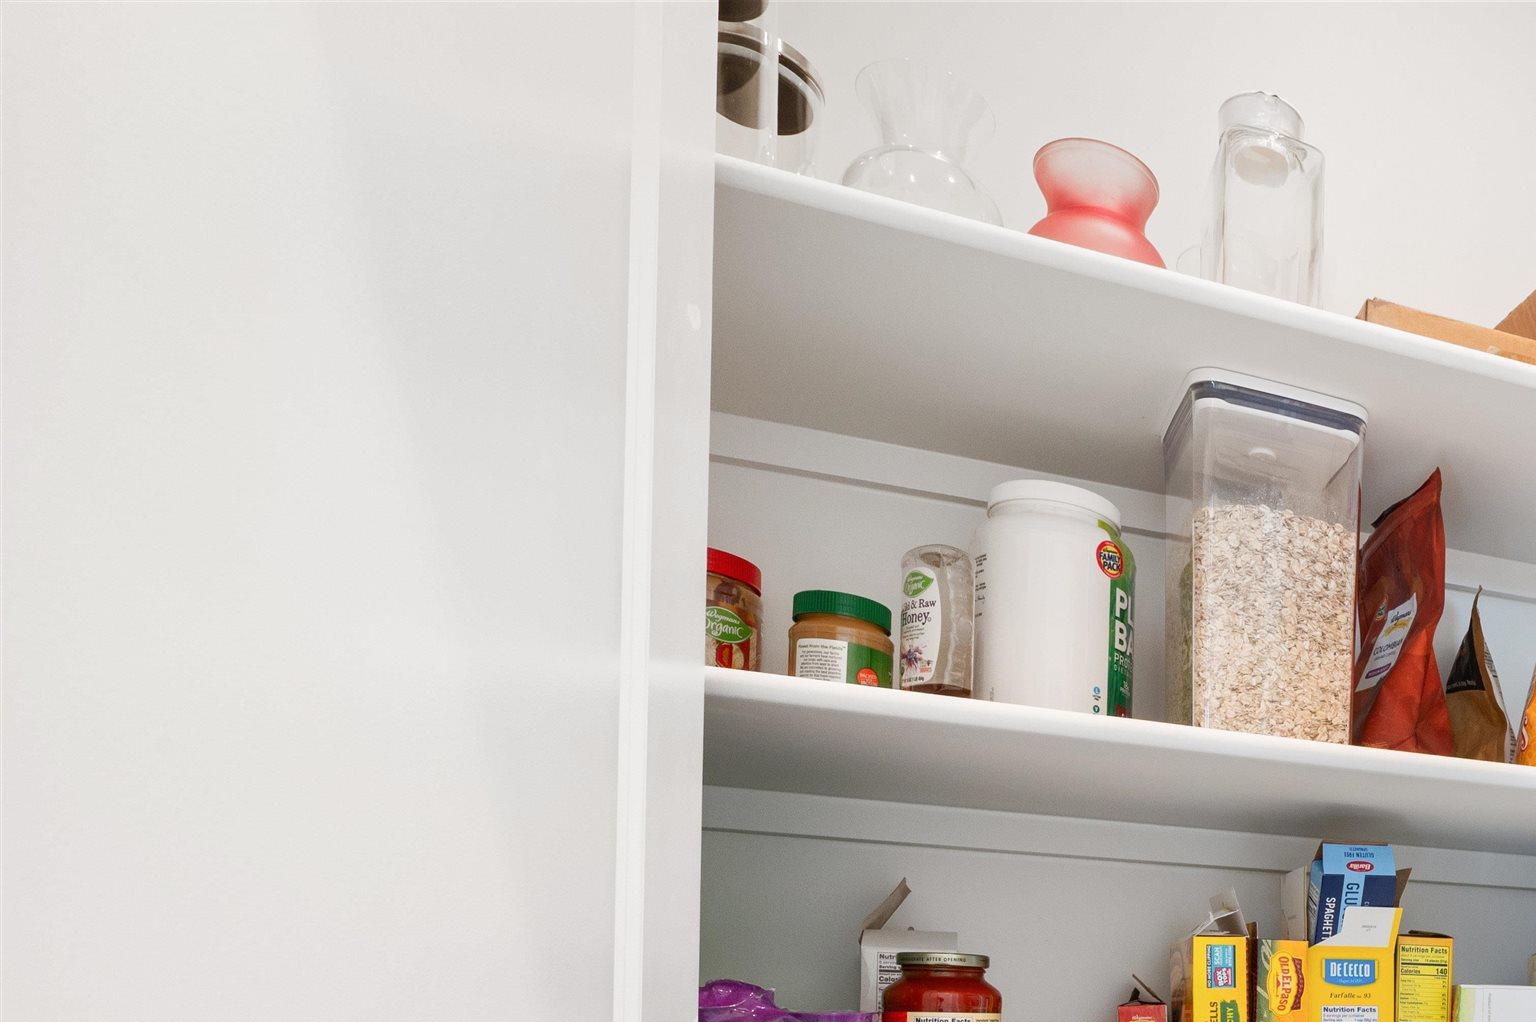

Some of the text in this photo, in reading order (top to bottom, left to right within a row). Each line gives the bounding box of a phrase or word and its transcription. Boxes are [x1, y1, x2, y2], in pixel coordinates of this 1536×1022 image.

[1103, 560, 1121, 571] PACK
[919, 599, 937, 608] Raw
[902, 610, 930, 626] Honey
[1330, 962, 1370, 977] DE CECCO
